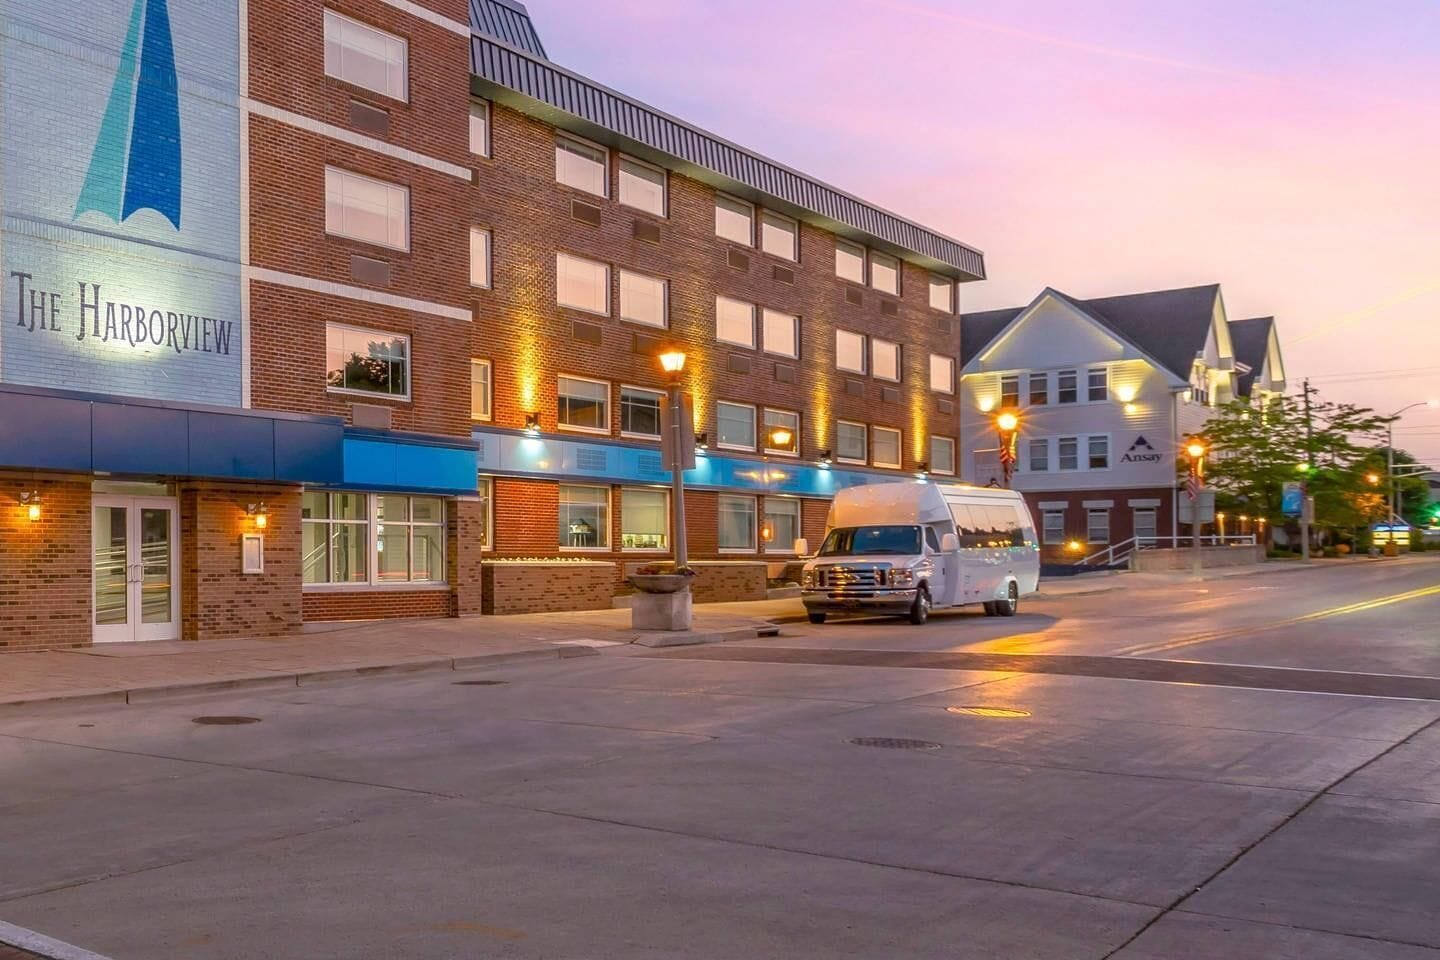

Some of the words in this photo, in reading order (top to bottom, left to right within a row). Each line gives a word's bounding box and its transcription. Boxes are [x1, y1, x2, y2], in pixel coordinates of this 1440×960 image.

[10, 271, 61, 333] THE
[76, 281, 233, 355] HARBORVIEW
[1120, 453, 1163, 464] Ansay
